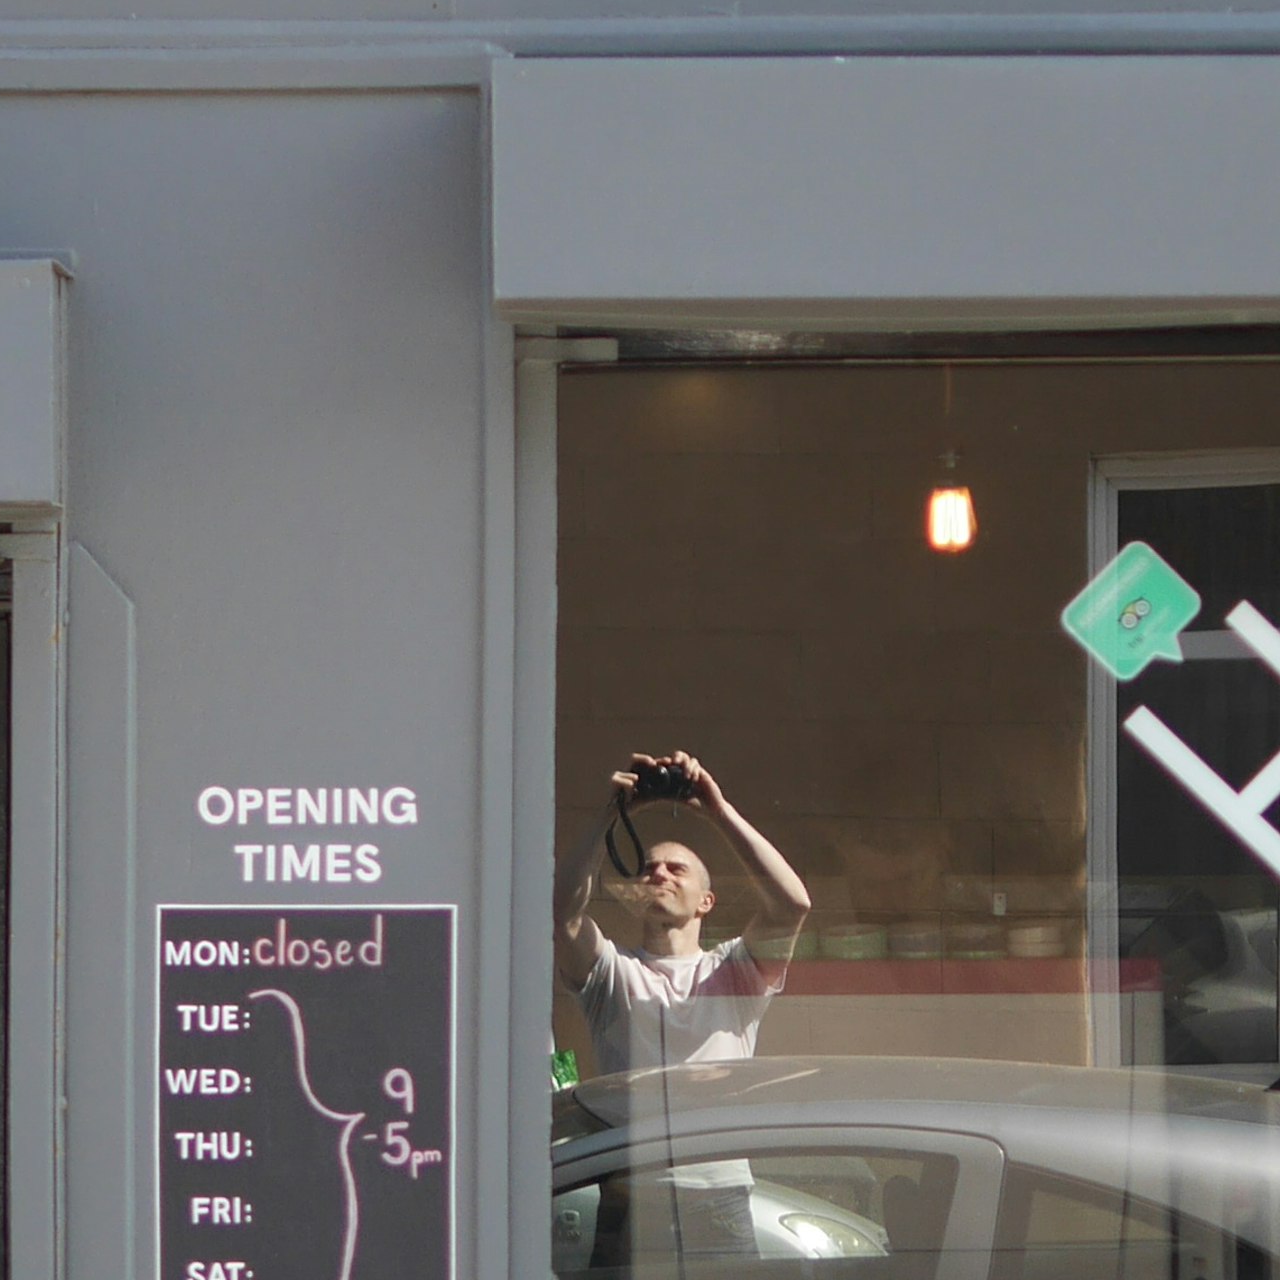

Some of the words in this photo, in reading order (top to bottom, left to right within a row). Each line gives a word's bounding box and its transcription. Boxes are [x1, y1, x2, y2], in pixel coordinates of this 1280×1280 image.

[197, 785, 418, 825] OPENING
[233, 843, 382, 883] TIMES
[164, 940, 251, 967] MON:
[253, 913, 383, 970] closed
[176, 1004, 251, 1033] TUE:
[164, 1068, 252, 1095] WED:
[382, 1067, 414, 1114] 9
[173, 1131, 253, 1161] THU:
[190, 1196, 253, 1225] FRI:
